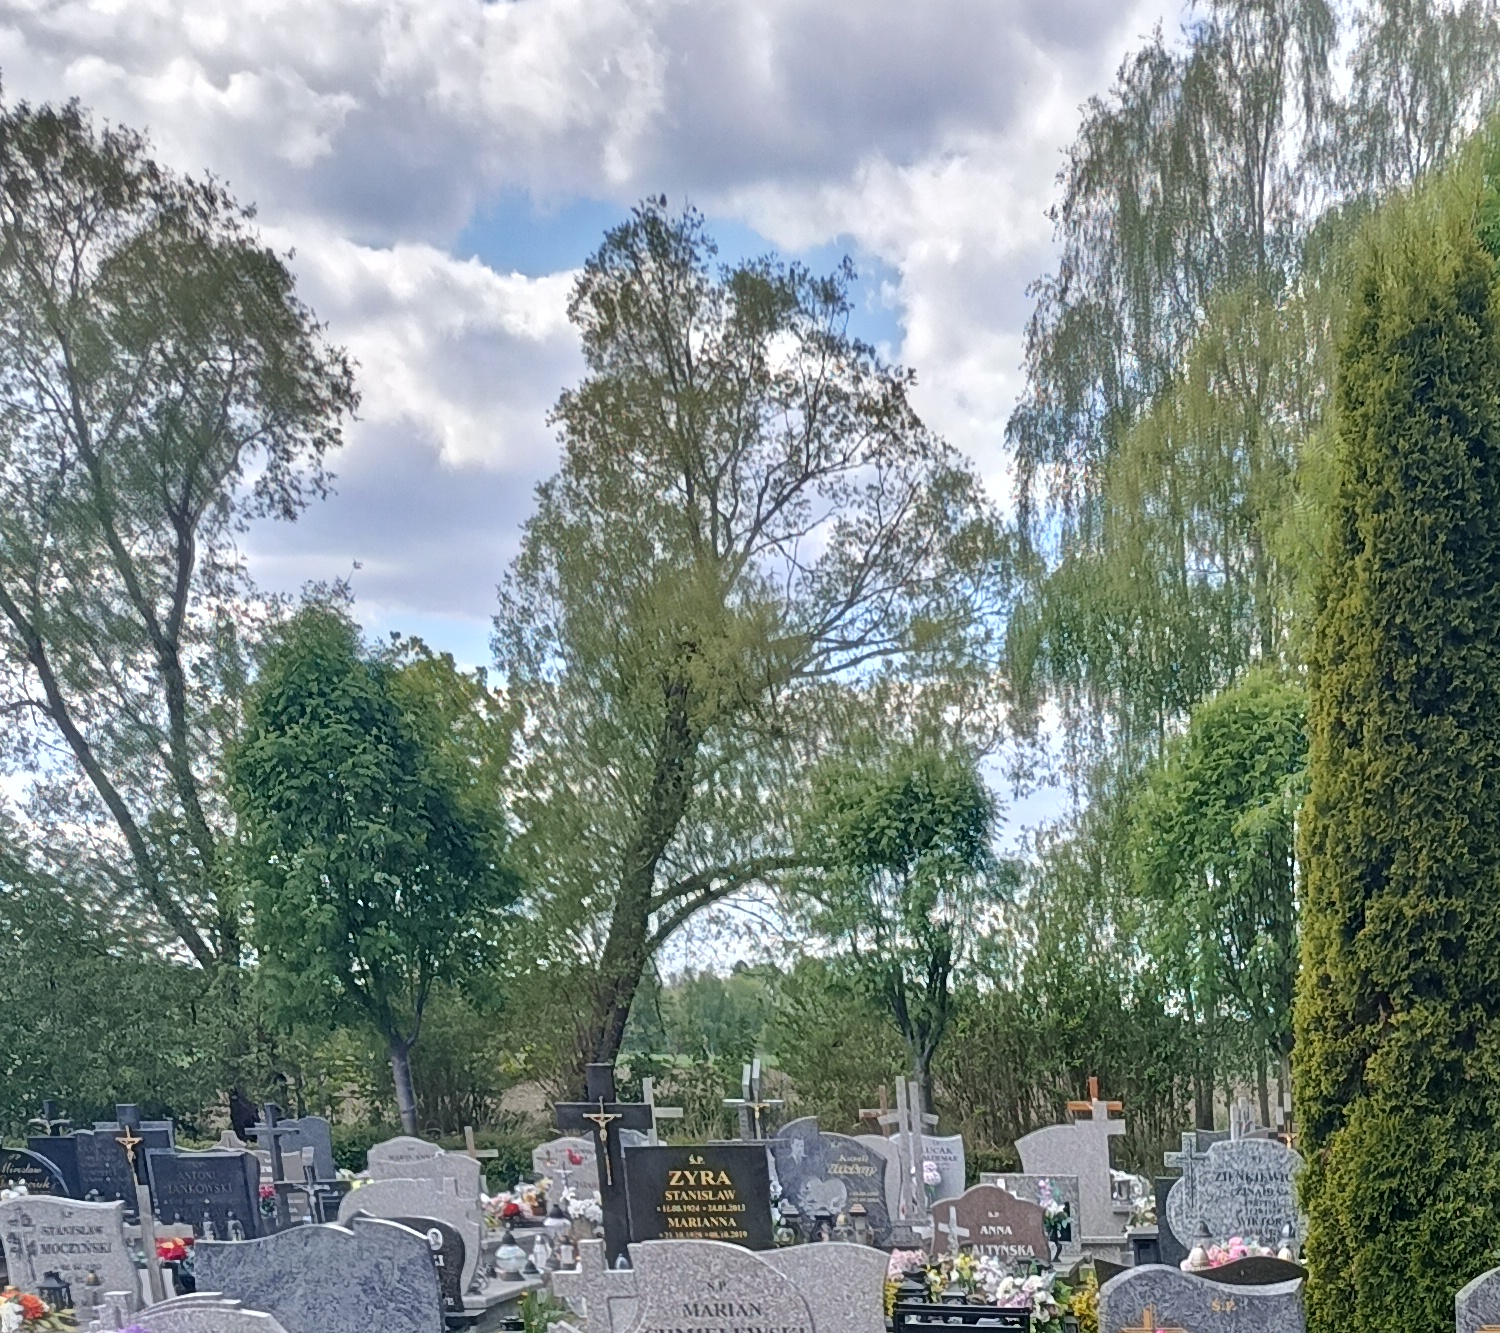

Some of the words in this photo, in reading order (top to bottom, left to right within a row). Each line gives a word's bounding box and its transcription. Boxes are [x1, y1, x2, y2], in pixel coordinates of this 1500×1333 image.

[667, 1217, 737, 1229] MARIANNA
[980, 1225, 1013, 1236] ANNA
[682, 1303, 763, 1318] MARIAN
